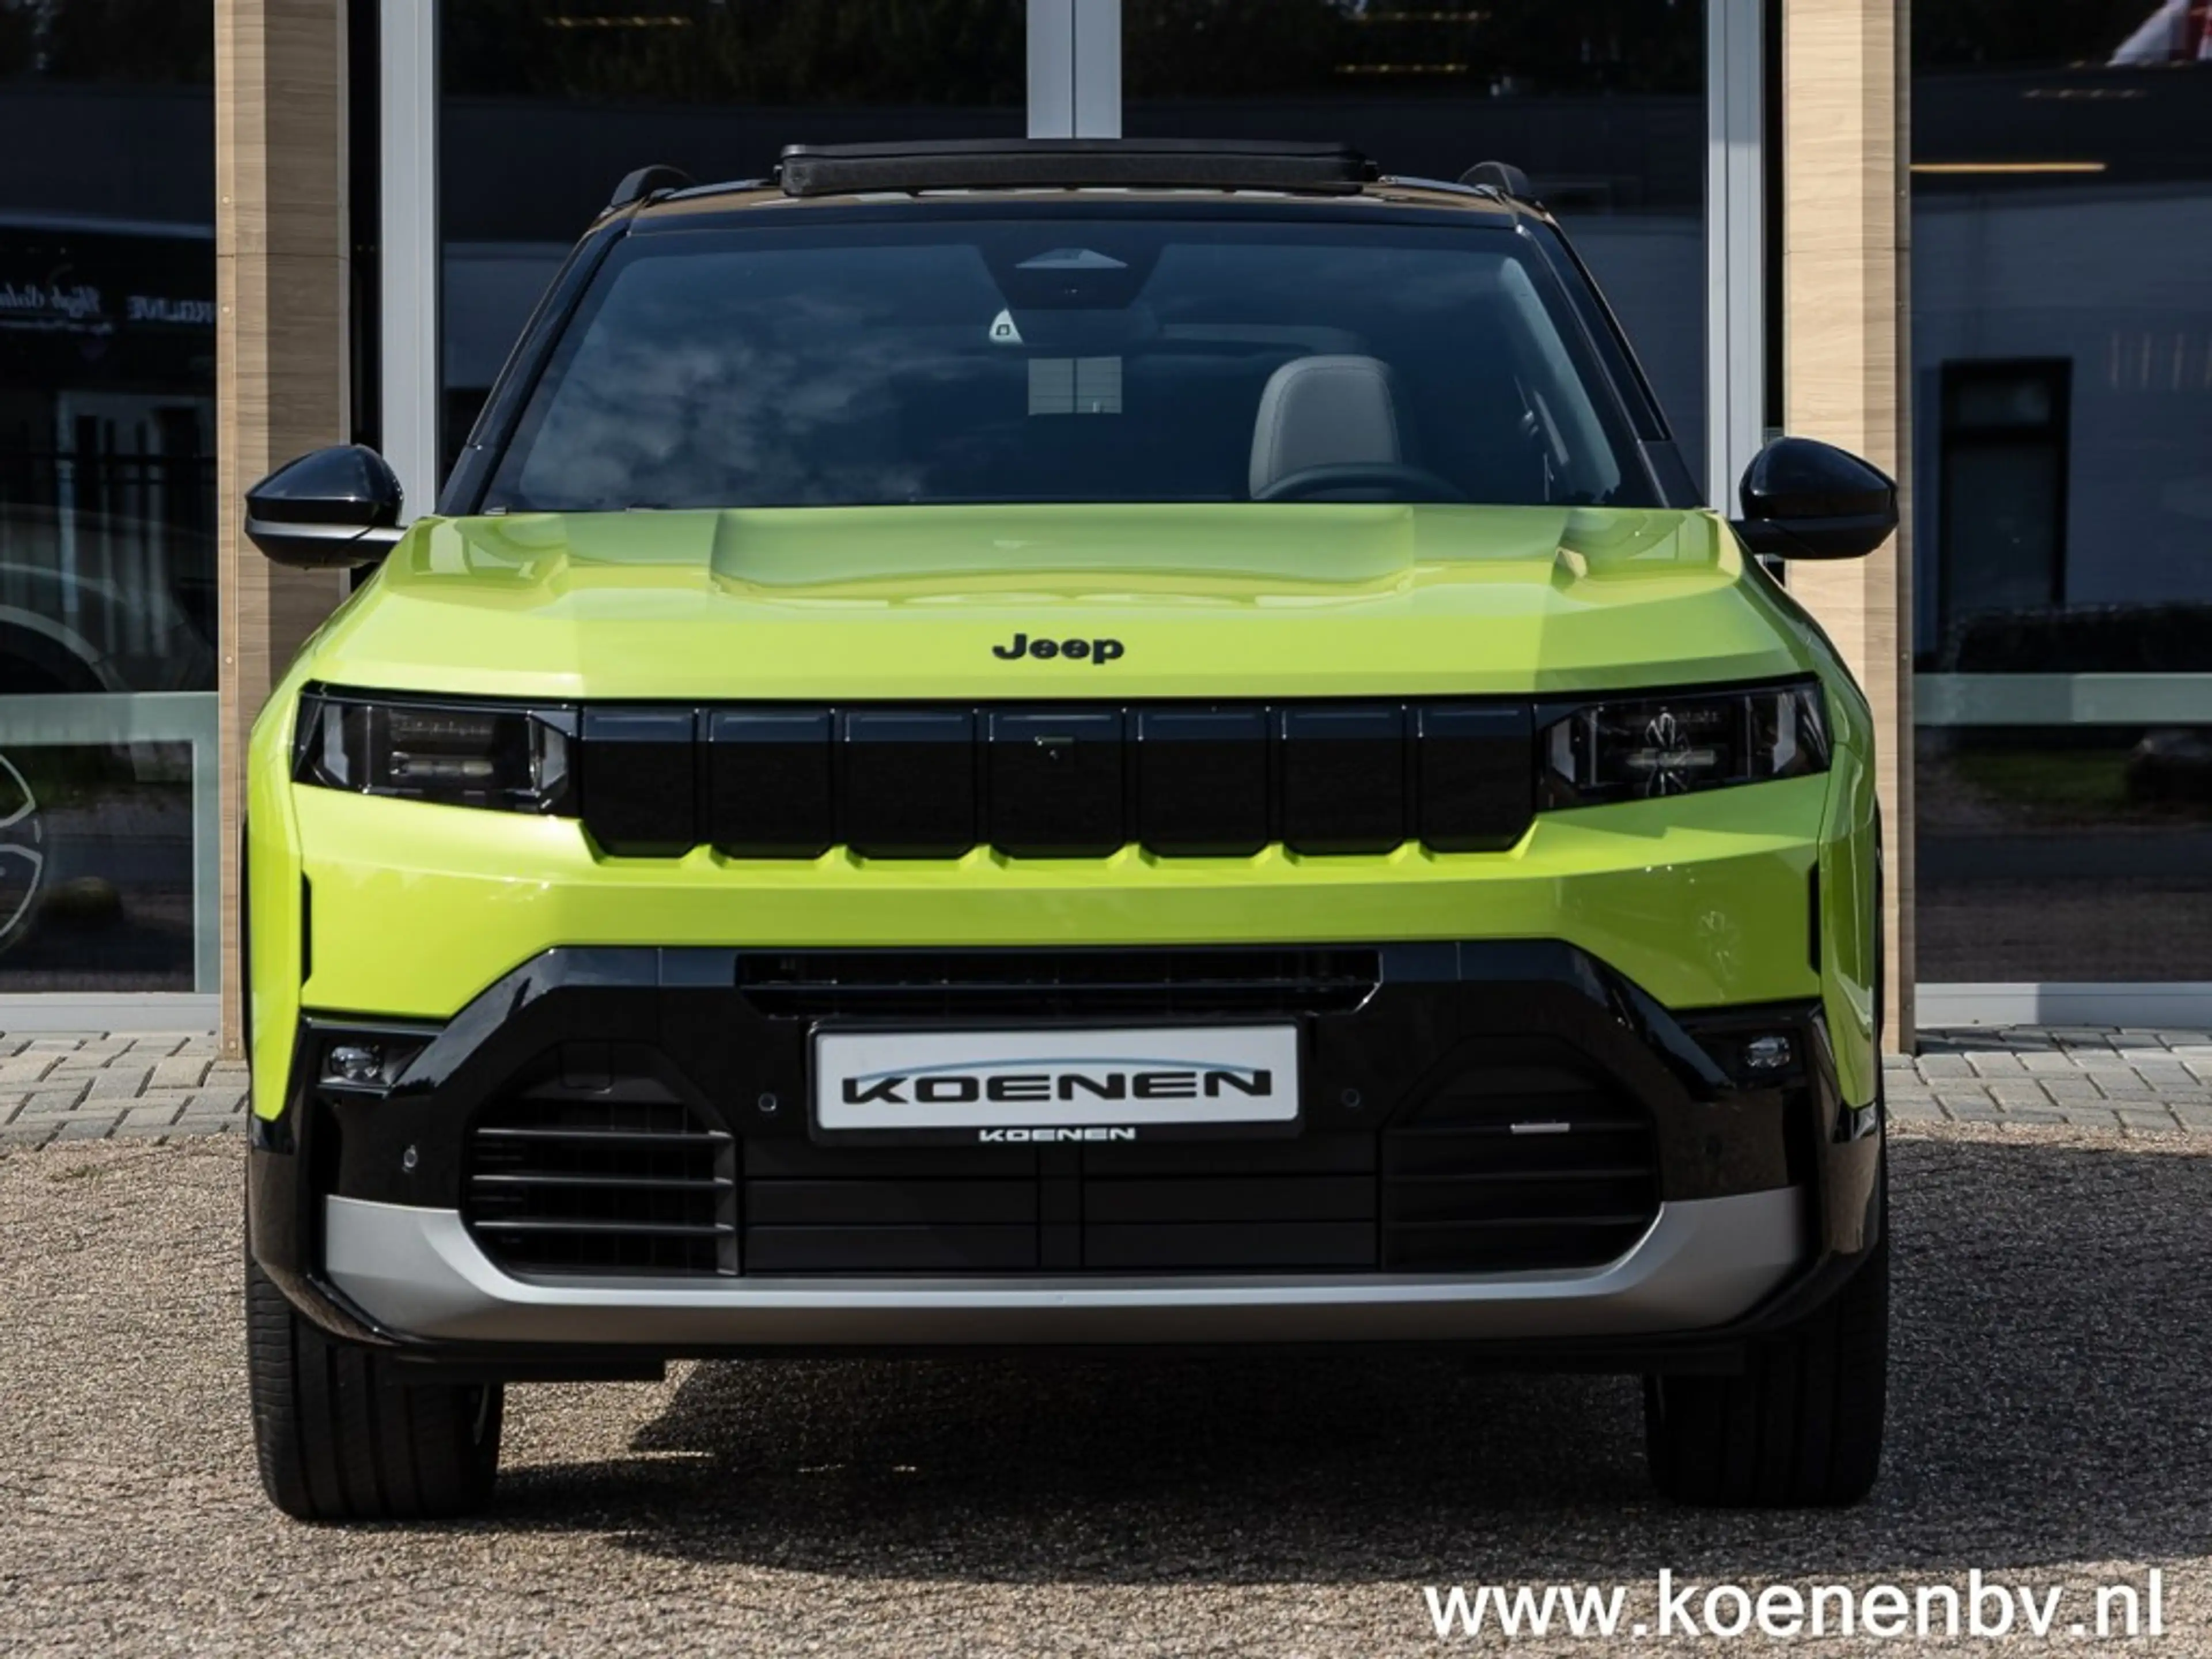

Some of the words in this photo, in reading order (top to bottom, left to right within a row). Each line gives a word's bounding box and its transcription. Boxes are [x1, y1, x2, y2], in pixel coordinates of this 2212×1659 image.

[993, 634, 1124, 664] Jeep
[842, 1070, 1272, 1104] KOENEN
[979, 1127, 1135, 1142] KOENEN
